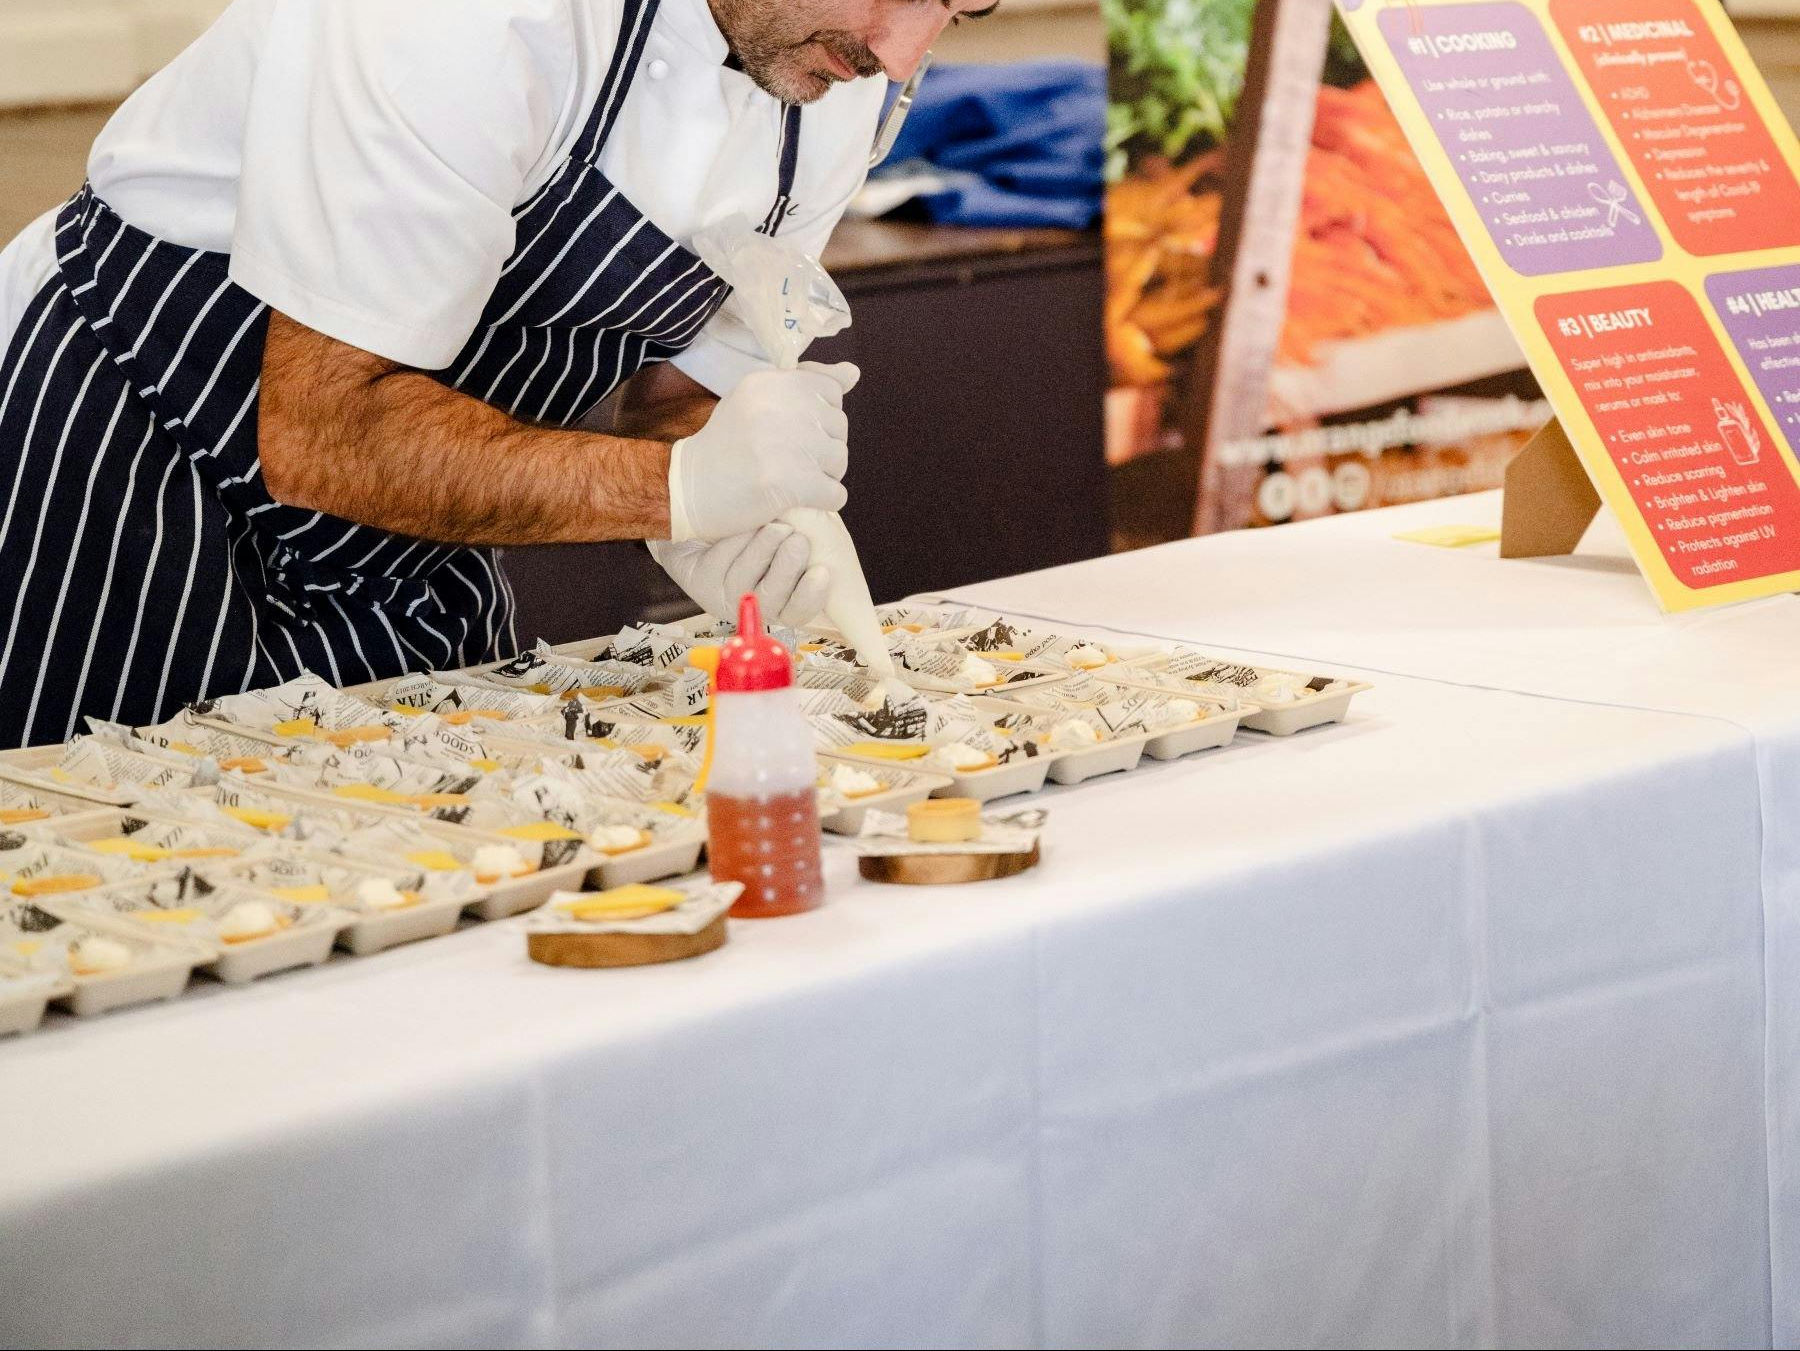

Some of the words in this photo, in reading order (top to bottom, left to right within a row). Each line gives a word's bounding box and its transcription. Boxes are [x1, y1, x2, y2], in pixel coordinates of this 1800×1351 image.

[1607, 19, 1693, 41] MEDICINAL
[1408, 37, 1427, 55] #1
[1435, 32, 1517, 53] COOKING
[1424, 80, 1443, 91] Use
[1444, 76, 1475, 89] whole
[1490, 73, 1527, 89] ground
[1474, 106, 1509, 121] potato
[1522, 100, 1560, 117] starchy
[1458, 128, 1490, 141] dishes
[1508, 147, 1539, 158] sweet
[1540, 144, 1549, 155] &
[1552, 143, 1590, 157] savoury
[1480, 170, 1509, 186] Dairy
[1509, 165, 1555, 183] products
[1554, 163, 1563, 175] &
[1564, 161, 1597, 174] dishes
[1492, 189, 1529, 204] Curries
[1503, 209, 1548, 225] Seafood
[1549, 208, 1558, 219] &
[1559, 203, 1599, 219] chicken
[1515, 232, 1546, 246] Drinks
[1546, 229, 1567, 242] and
[1568, 224, 1613, 240] cocktails
[1726, 296, 1749, 315] #4
[1558, 317, 1581, 337] #3
[1590, 307, 1654, 333] BEAUTY
[1765, 334, 1792, 348] been
[1572, 356, 1602, 374] Super
[1602, 354, 1625, 369] high
[1626, 354, 1637, 364] in
[1584, 381, 1601, 391] mix
[1603, 376, 1623, 388] into
[1624, 376, 1645, 388] your
[1631, 398, 1641, 408] or
[1641, 391, 1666, 405] mask
[1619, 428, 1645, 443] Even
[1645, 425, 1665, 438] skin
[1668, 423, 1690, 435] tone
[1631, 450, 1659, 464] Calm
[1661, 443, 1701, 460] irritated
[1702, 440, 1721, 452] skin
[1643, 469, 1682, 487] Reduce
[1685, 467, 1725, 483] scarring
[1655, 491, 1699, 512] Brighten
[1699, 490, 1707, 501] &
[1710, 483, 1747, 503] Lighten
[1746, 480, 1765, 492] skin
[1667, 514, 1706, 531] Reduce
[1708, 504, 1774, 527] pigmentation
[1679, 535, 1720, 553] Protects
[1723, 530, 1762, 549] against
[1761, 526, 1776, 538] UV
[1691, 557, 1737, 575] radiation
[657, 641, 684, 669] THE
